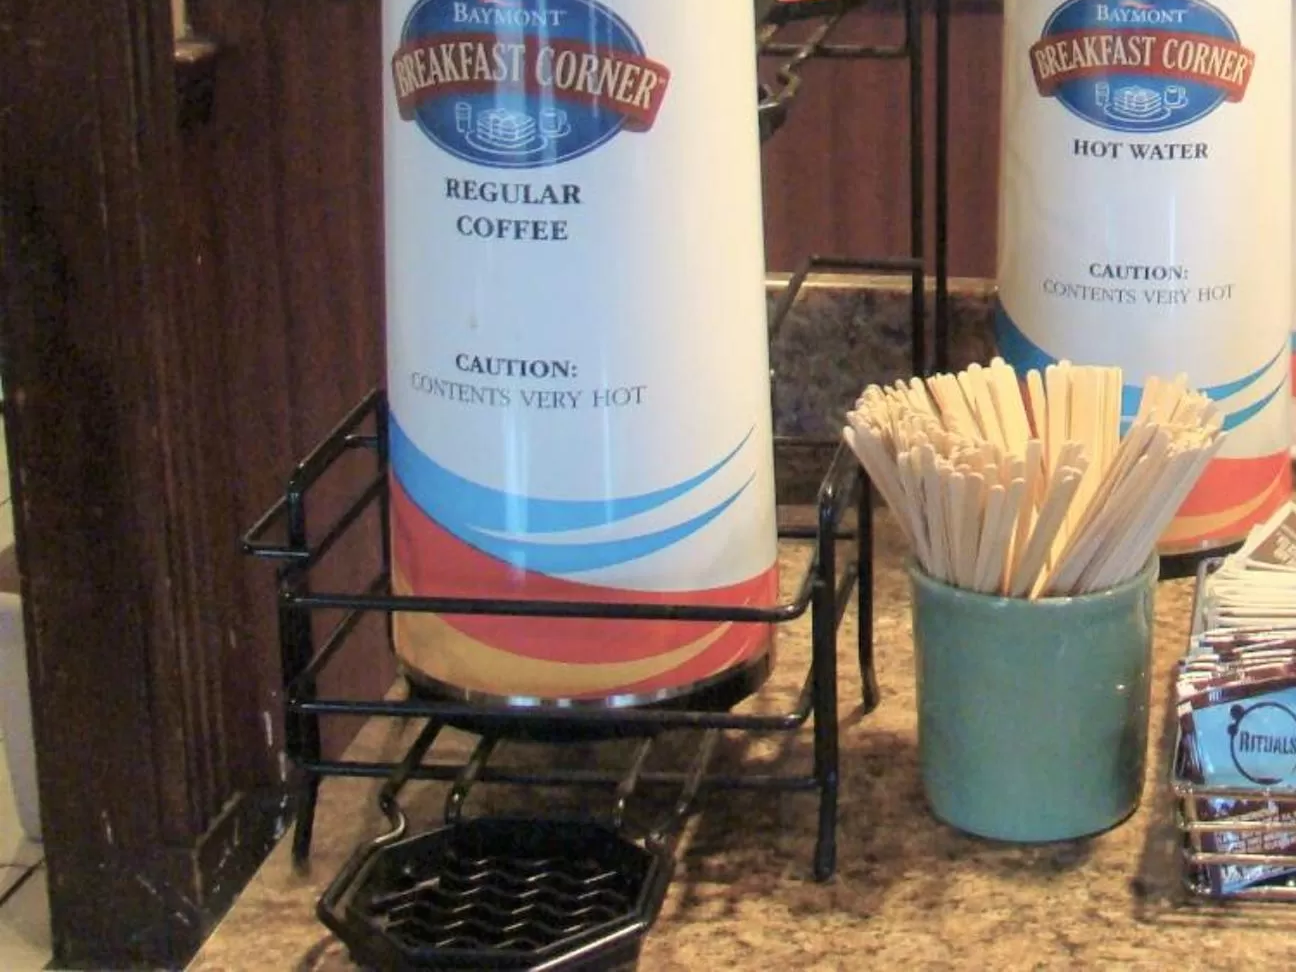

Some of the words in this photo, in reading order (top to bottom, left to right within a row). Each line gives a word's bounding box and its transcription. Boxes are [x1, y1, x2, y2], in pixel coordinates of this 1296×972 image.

[452, 2, 563, 26] BAYMONT
[1096, 3, 1188, 24] BAYMONT
[1034, 35, 1156, 79] BREAKFAST
[1162, 38, 1249, 88] CORNER
[396, 41, 526, 97] BREAKFAST
[536, 46, 661, 110] CORNER
[1073, 138, 1123, 159] HOT
[1130, 143, 1209, 160] WATER
[445, 178, 580, 205] REGULAR
[456, 215, 568, 241] COFFEE
[1089, 263, 1189, 280] CAUTION:
[1043, 280, 1136, 304] CONTENTS
[1143, 290, 1191, 305] VERY
[1199, 284, 1236, 303] HOT
[455, 353, 578, 378] CAUTION:
[411, 372, 511, 407] CONTENTS
[519, 390, 582, 409] VERY
[592, 386, 647, 408] HOT
